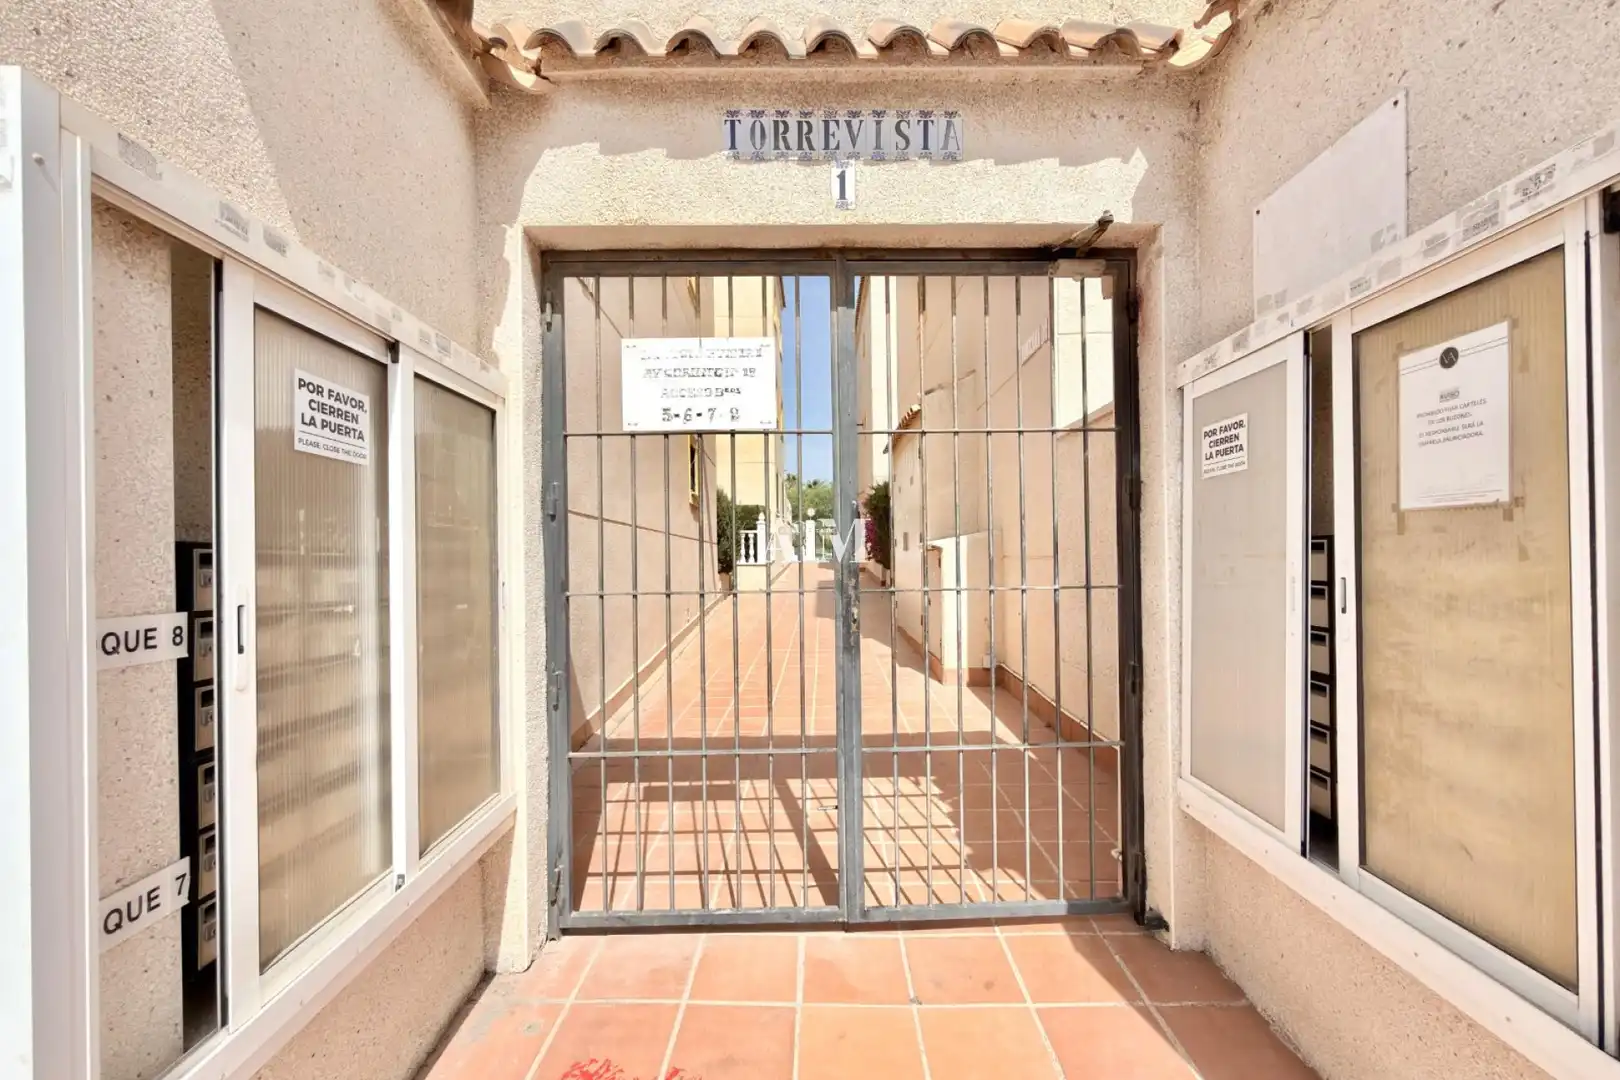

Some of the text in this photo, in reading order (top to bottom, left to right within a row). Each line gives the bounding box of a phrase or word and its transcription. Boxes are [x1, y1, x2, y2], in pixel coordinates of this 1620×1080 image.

[723, 119, 961, 151] TORREVISTA
[835, 169, 848, 201] 1
[297, 377, 368, 413] POR FAVOR,
[301, 412, 365, 442] LA PUERTA
[308, 399, 359, 425] CIERREN
[1203, 428, 1218, 440] POR
[1208, 432, 1240, 449] CIERREN
[1205, 443, 1244, 460] LA PUERTA
[101, 625, 184, 656] QUE 8
[103, 873, 187, 935] QUE 7
